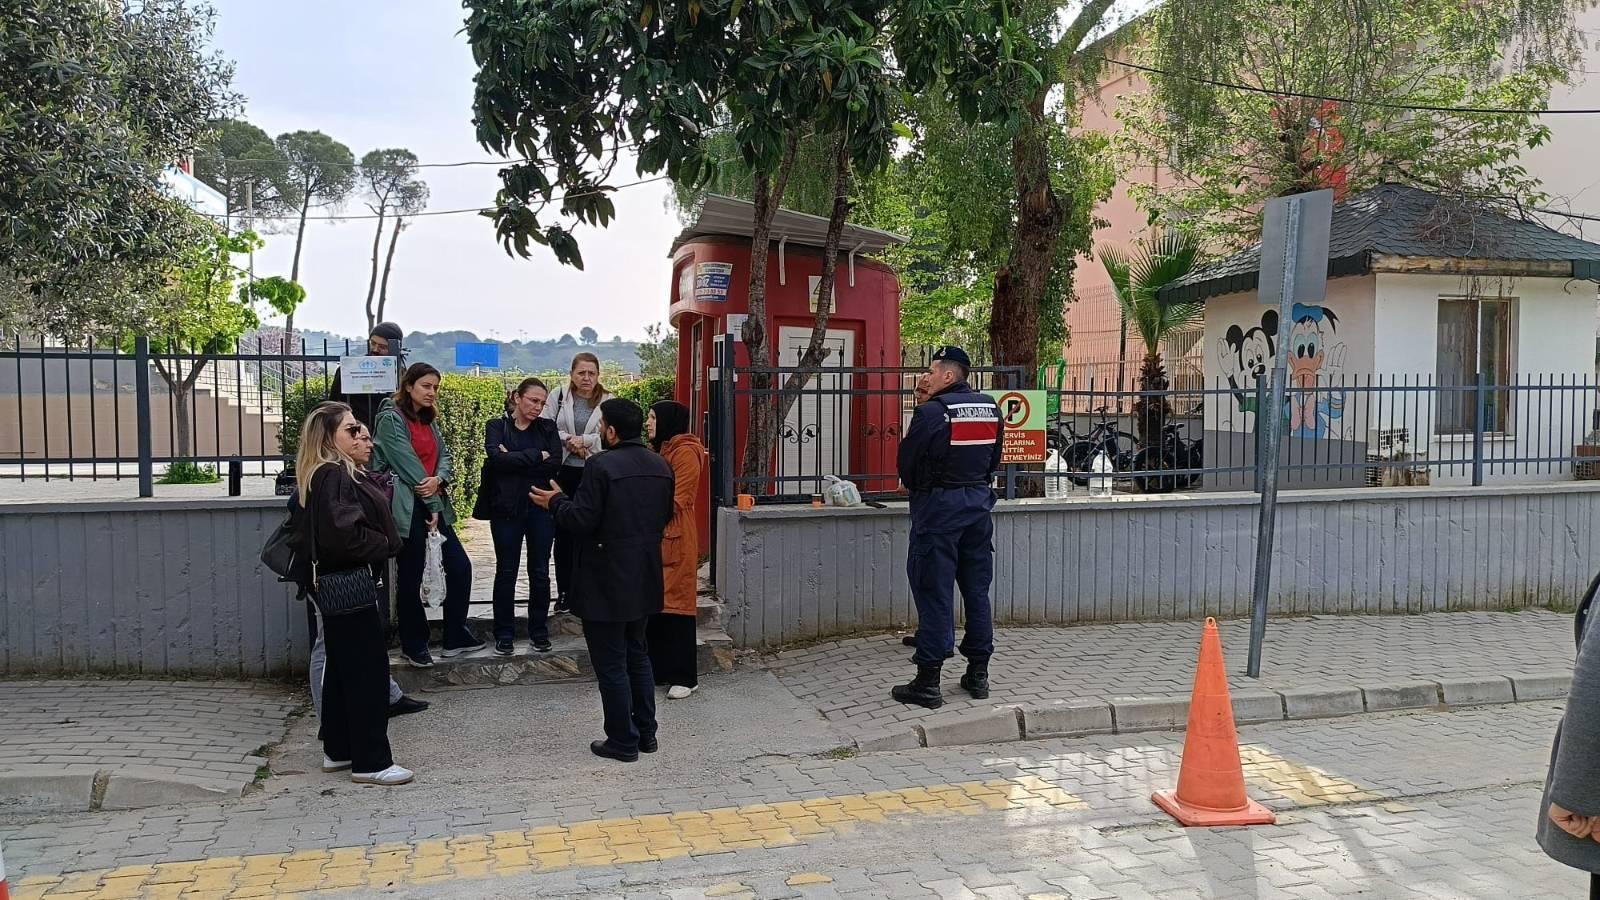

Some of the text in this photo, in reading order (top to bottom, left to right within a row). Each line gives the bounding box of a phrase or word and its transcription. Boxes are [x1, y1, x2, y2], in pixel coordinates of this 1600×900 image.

[956, 407, 994, 418] JANDARMA
[1004, 431, 1026, 439] ERVİS
[1003, 453, 1043, 461] ETMEYİNİZ
